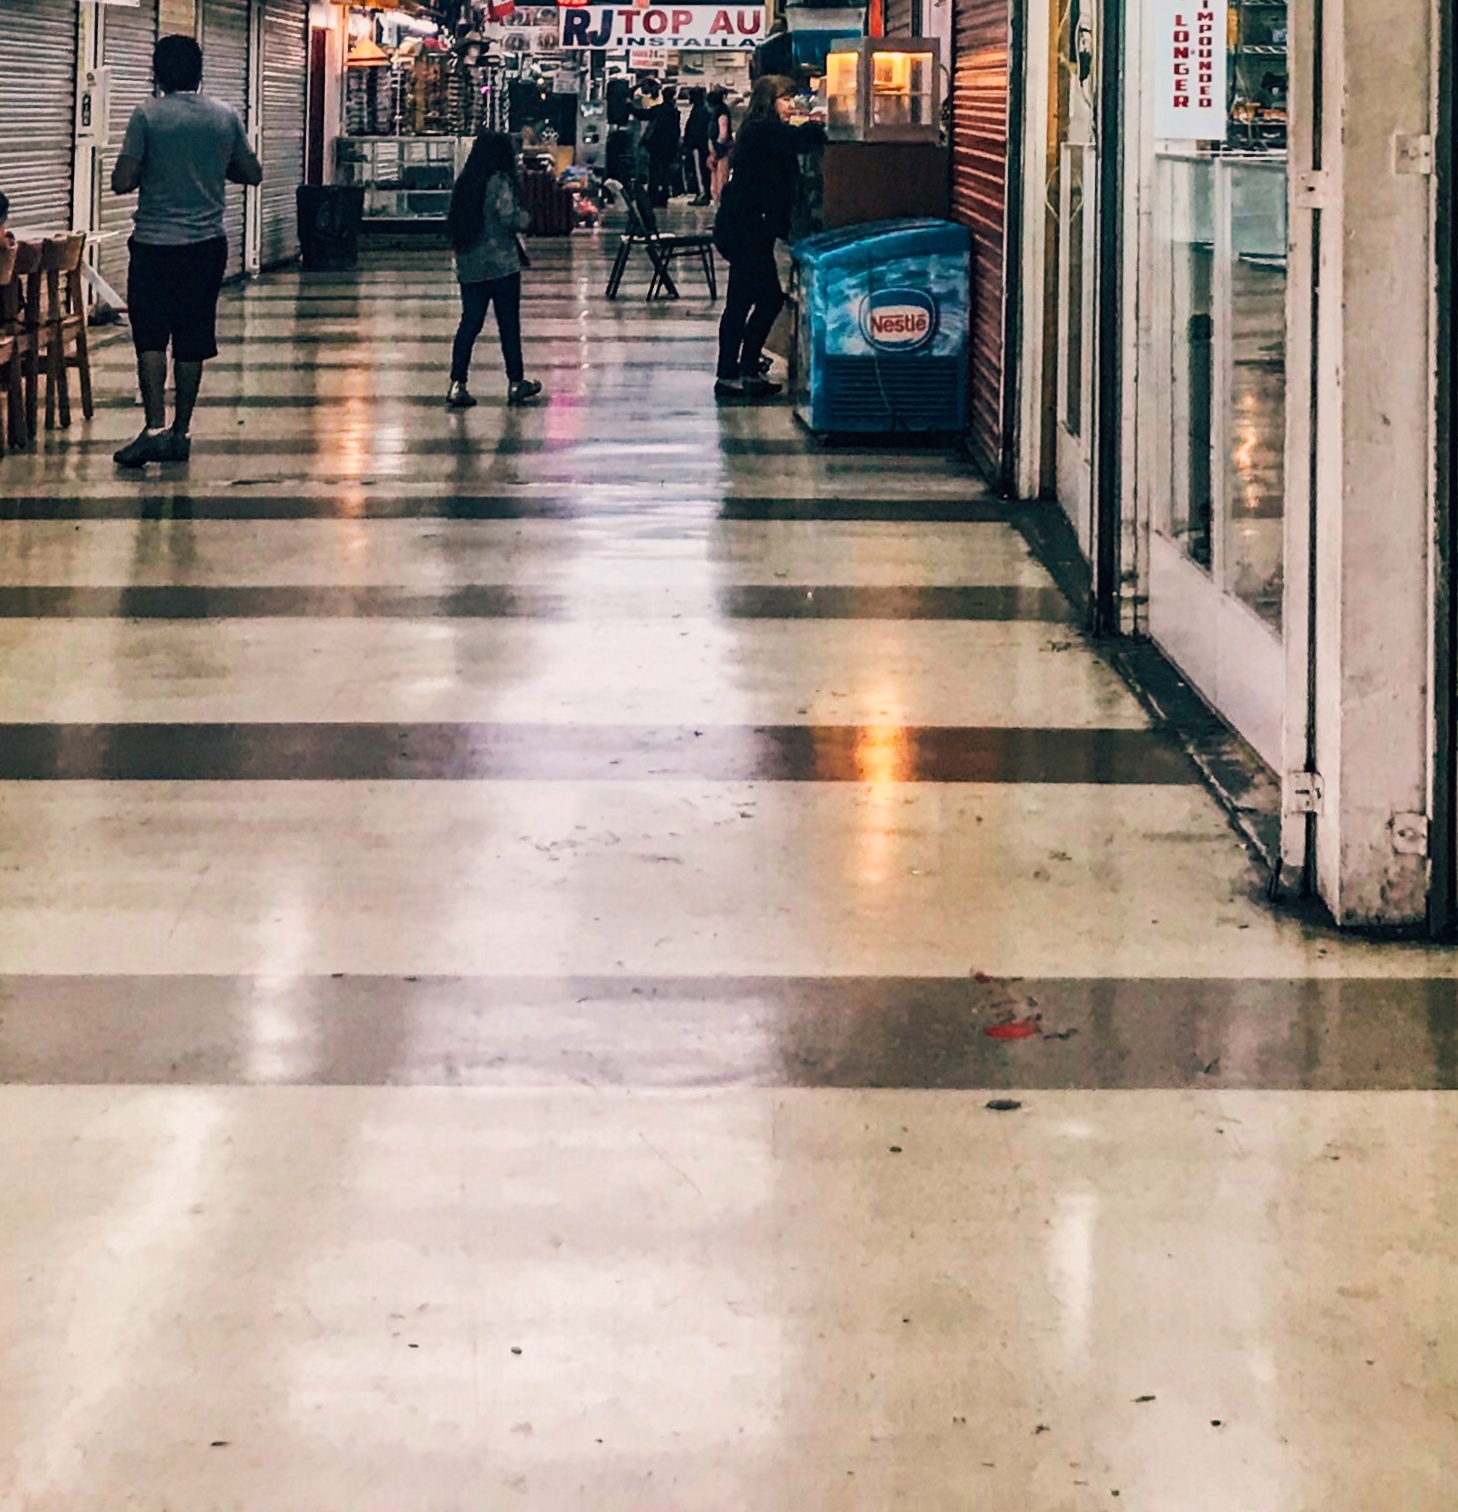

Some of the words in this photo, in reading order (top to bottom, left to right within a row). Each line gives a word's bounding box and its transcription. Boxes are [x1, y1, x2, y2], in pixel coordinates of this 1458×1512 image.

[562, 9, 614, 47] RJ
[617, 9, 694, 35] TOP
[1173, 14, 1190, 108] LONGER
[1197, 0, 1214, 108] IMPOUNDED
